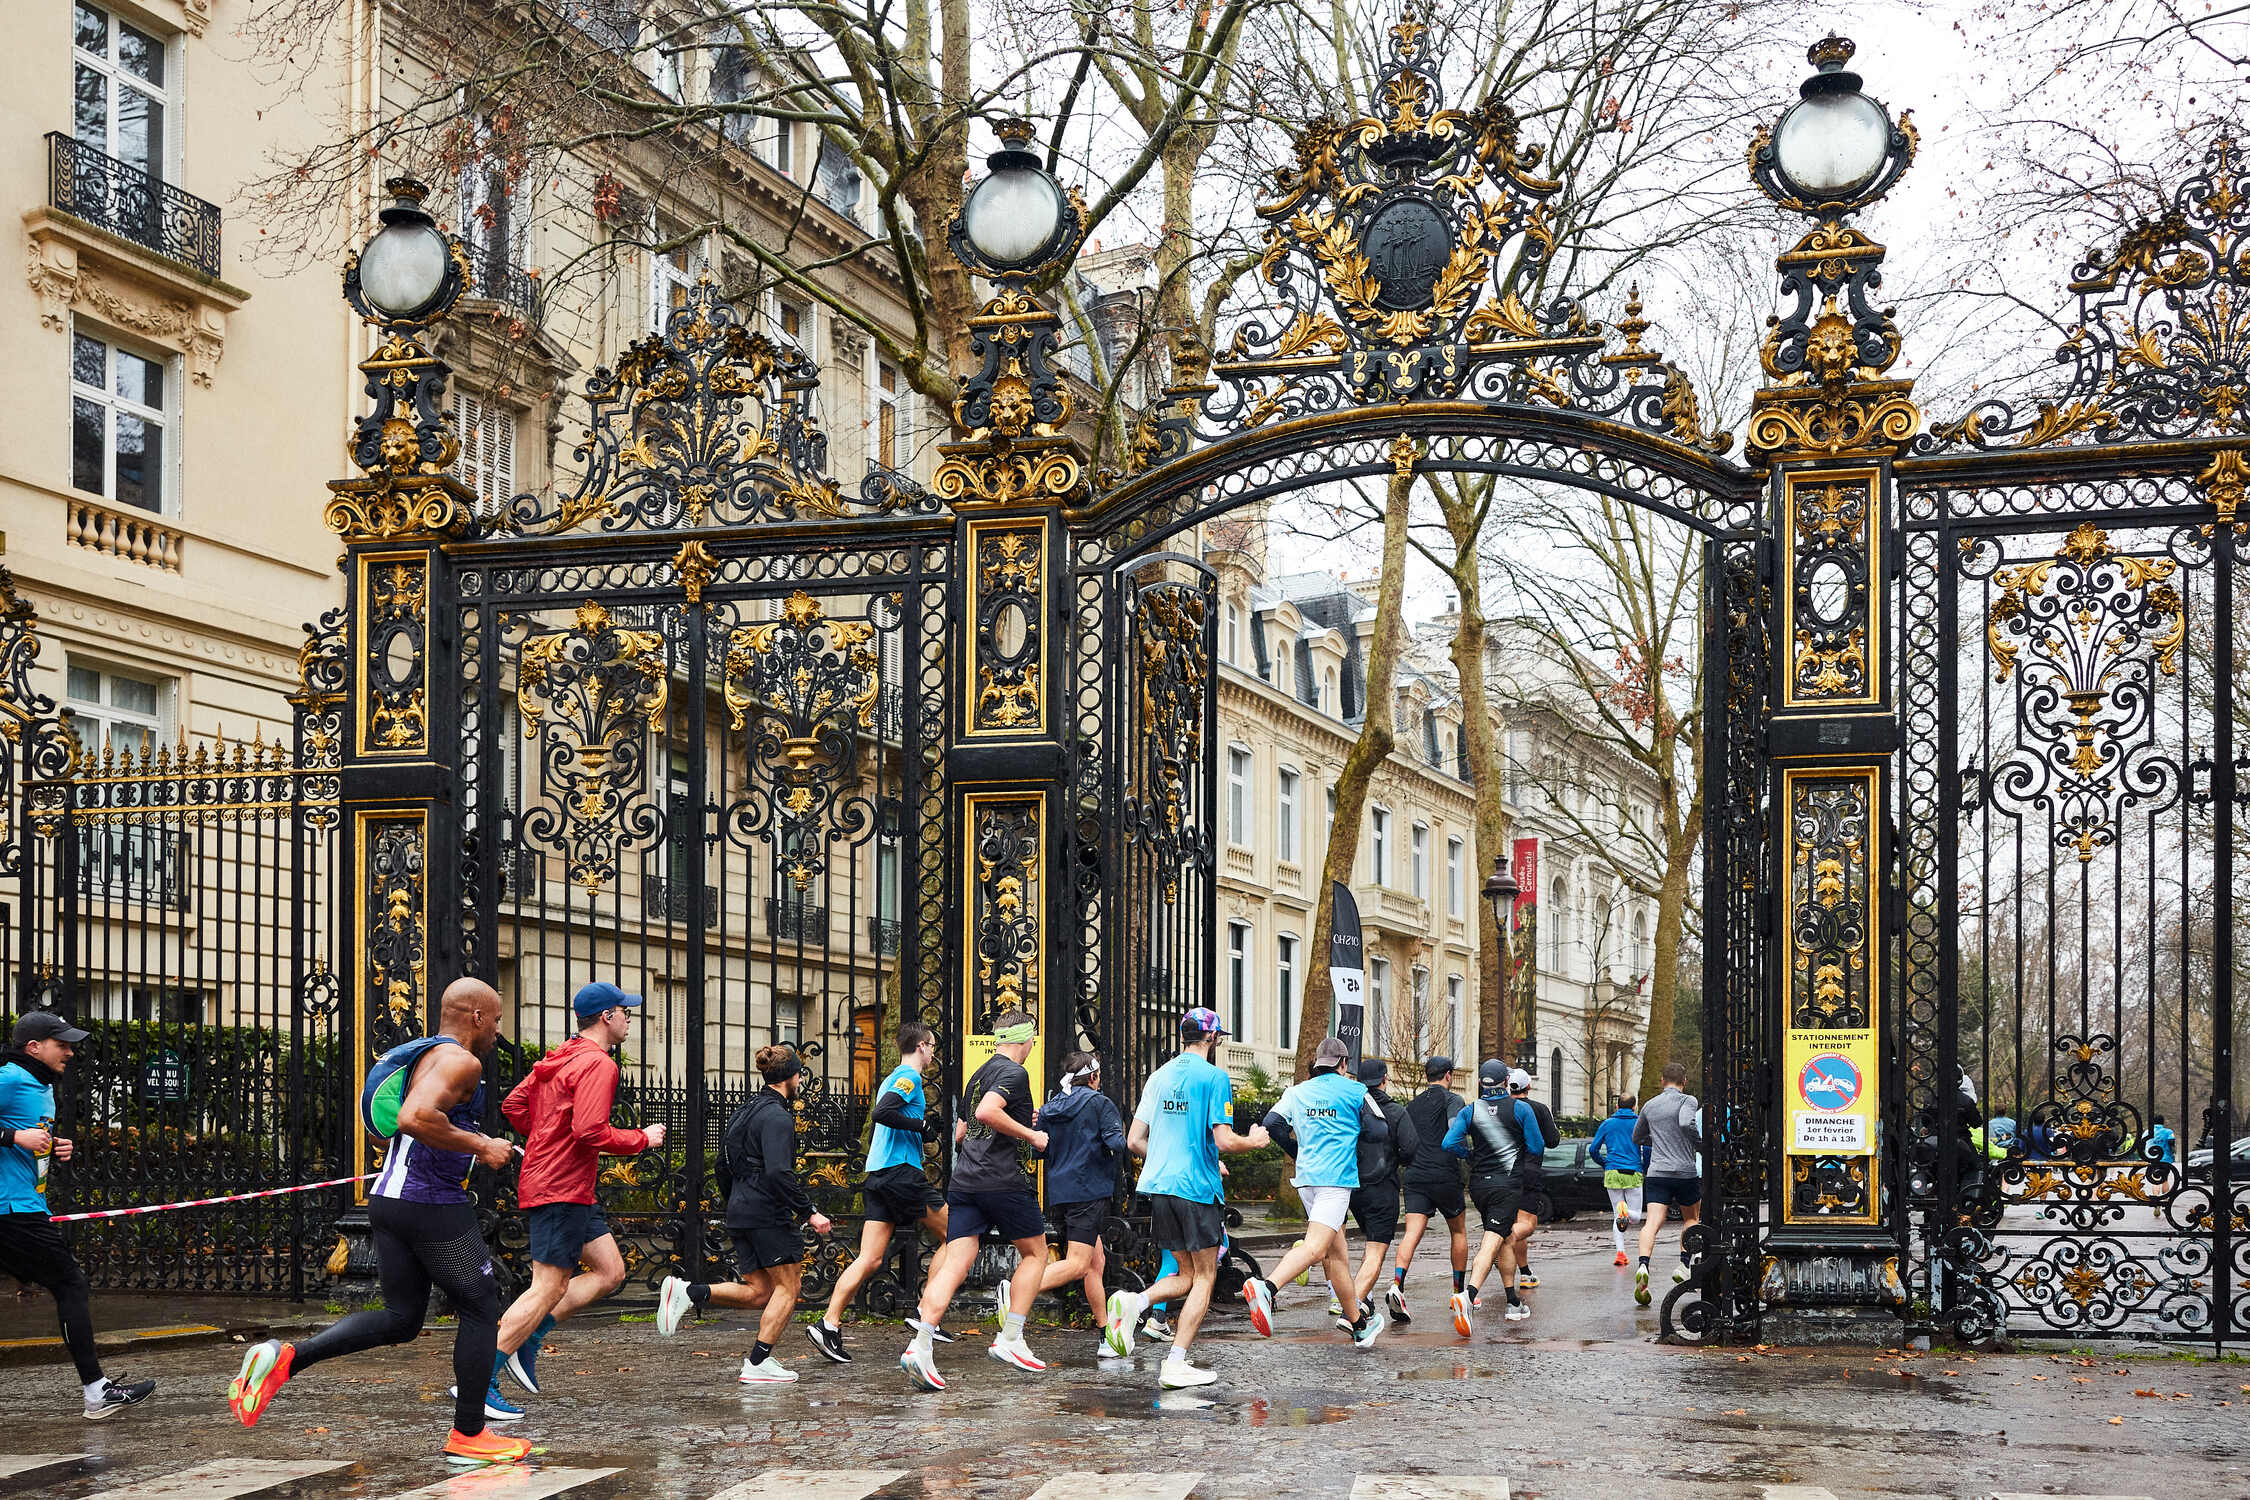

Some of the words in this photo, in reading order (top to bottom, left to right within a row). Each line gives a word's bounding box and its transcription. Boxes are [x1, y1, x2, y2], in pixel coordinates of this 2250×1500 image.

[1525, 851, 1533, 892] Cernuschi
[1163, 1100, 1174, 1111] 10
[1306, 1108, 1317, 1117] 10
[1824, 1126, 1853, 1134] février
